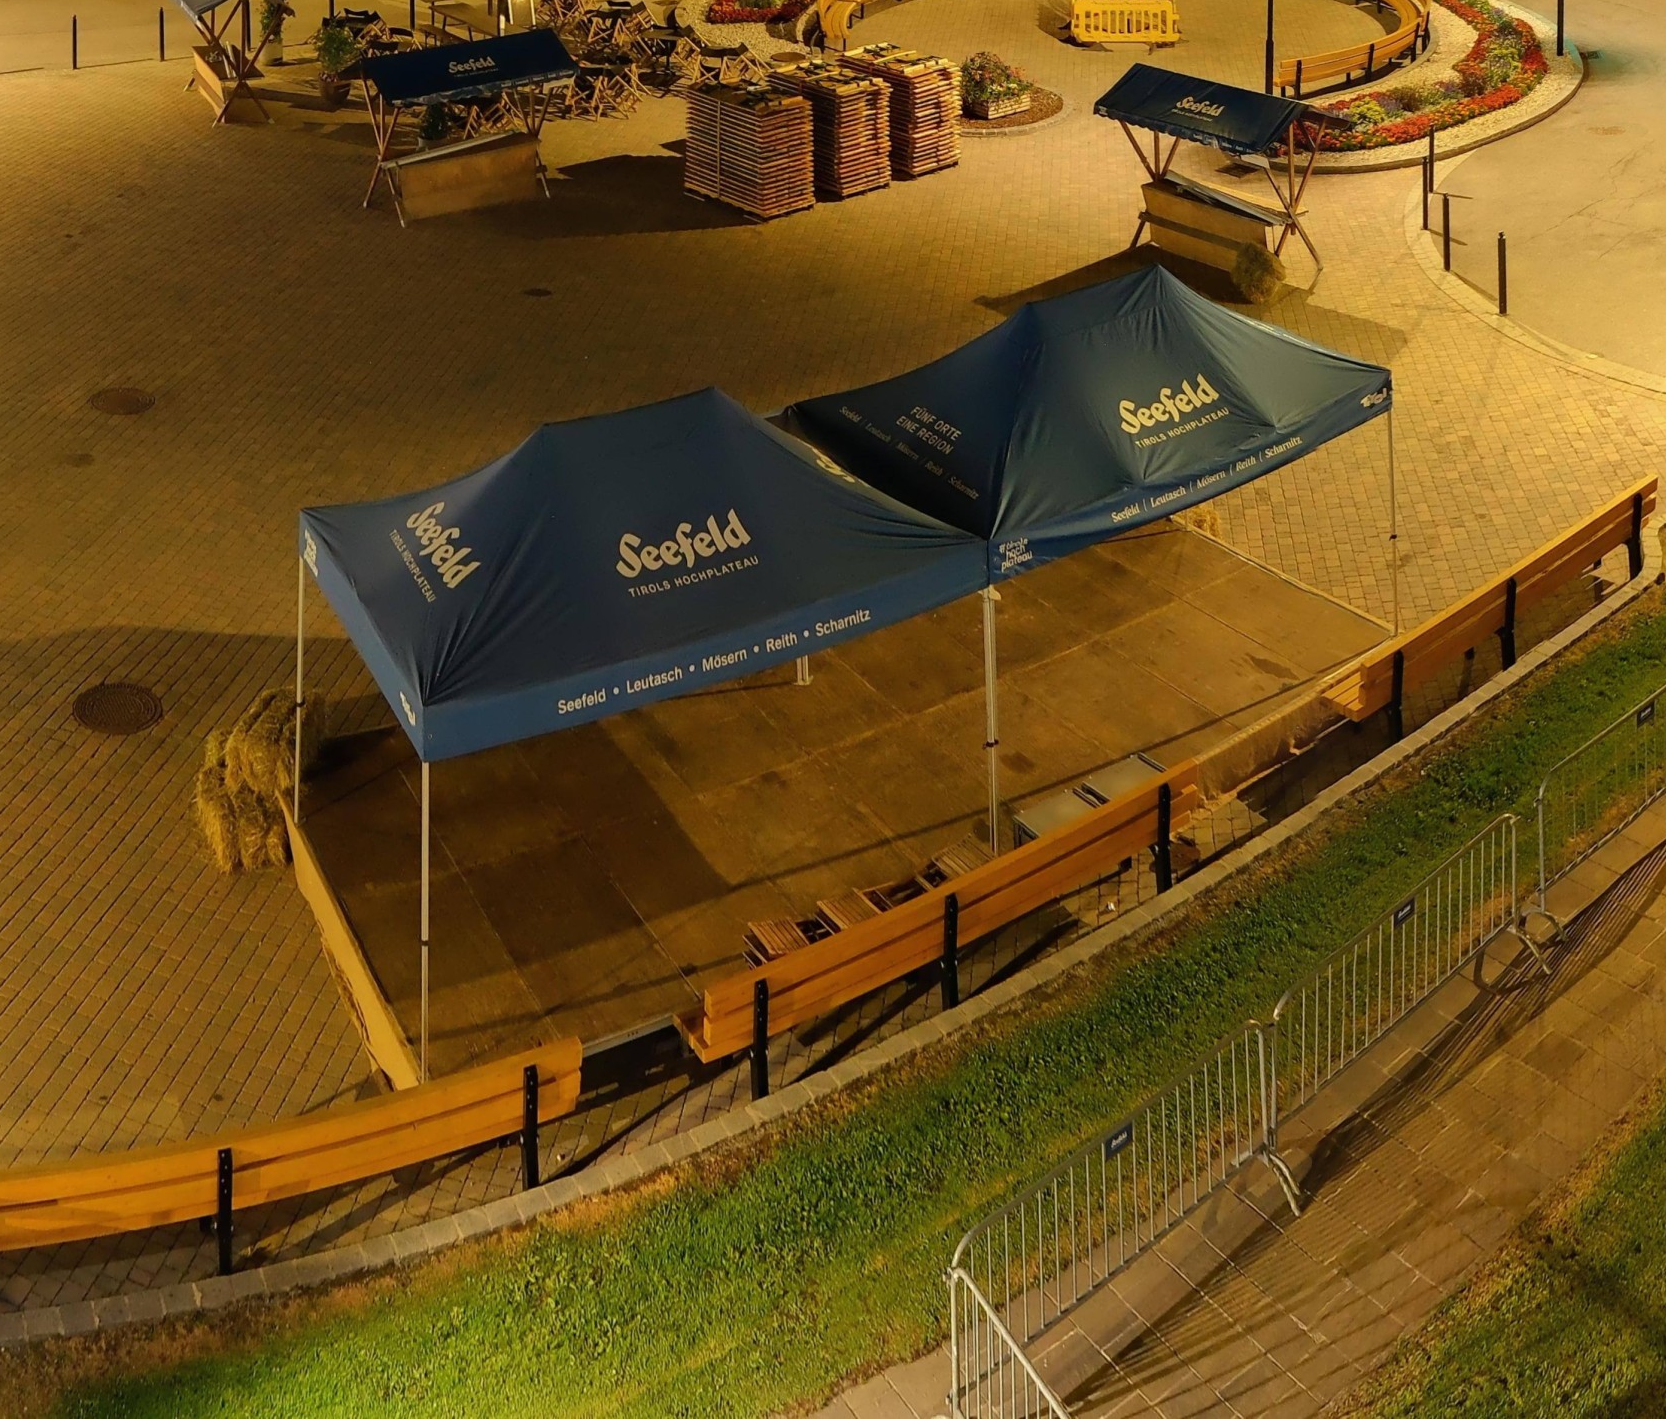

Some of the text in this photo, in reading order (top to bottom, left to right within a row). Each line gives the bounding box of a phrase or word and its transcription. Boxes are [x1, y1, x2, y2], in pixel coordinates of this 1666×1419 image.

[448, 56, 496, 73] Seefeld
[1176, 96, 1226, 117] Seefeld
[910, 405, 963, 441] FÜNF ORTE
[1118, 373, 1220, 435] Seefeld
[896, 415, 955, 456] EINE REGION
[1134, 407, 1230, 449] TIROLS HOCHPLATEAU
[1111, 434, 1303, 524] Seefeld Leutasch Mösern Reith Scharnitz
[406, 501, 482, 589] Seefeld
[615, 508, 753, 579] Seefeld
[1001, 550, 1033, 574] plateau
[388, 528, 437, 603] TIROLS HOCHPLATEAU
[628, 555, 760, 598] TIROLS HOCHPLATEAU
[557, 607, 871, 715] Seefeld Leutasch Mösern Reith Scharnitz
